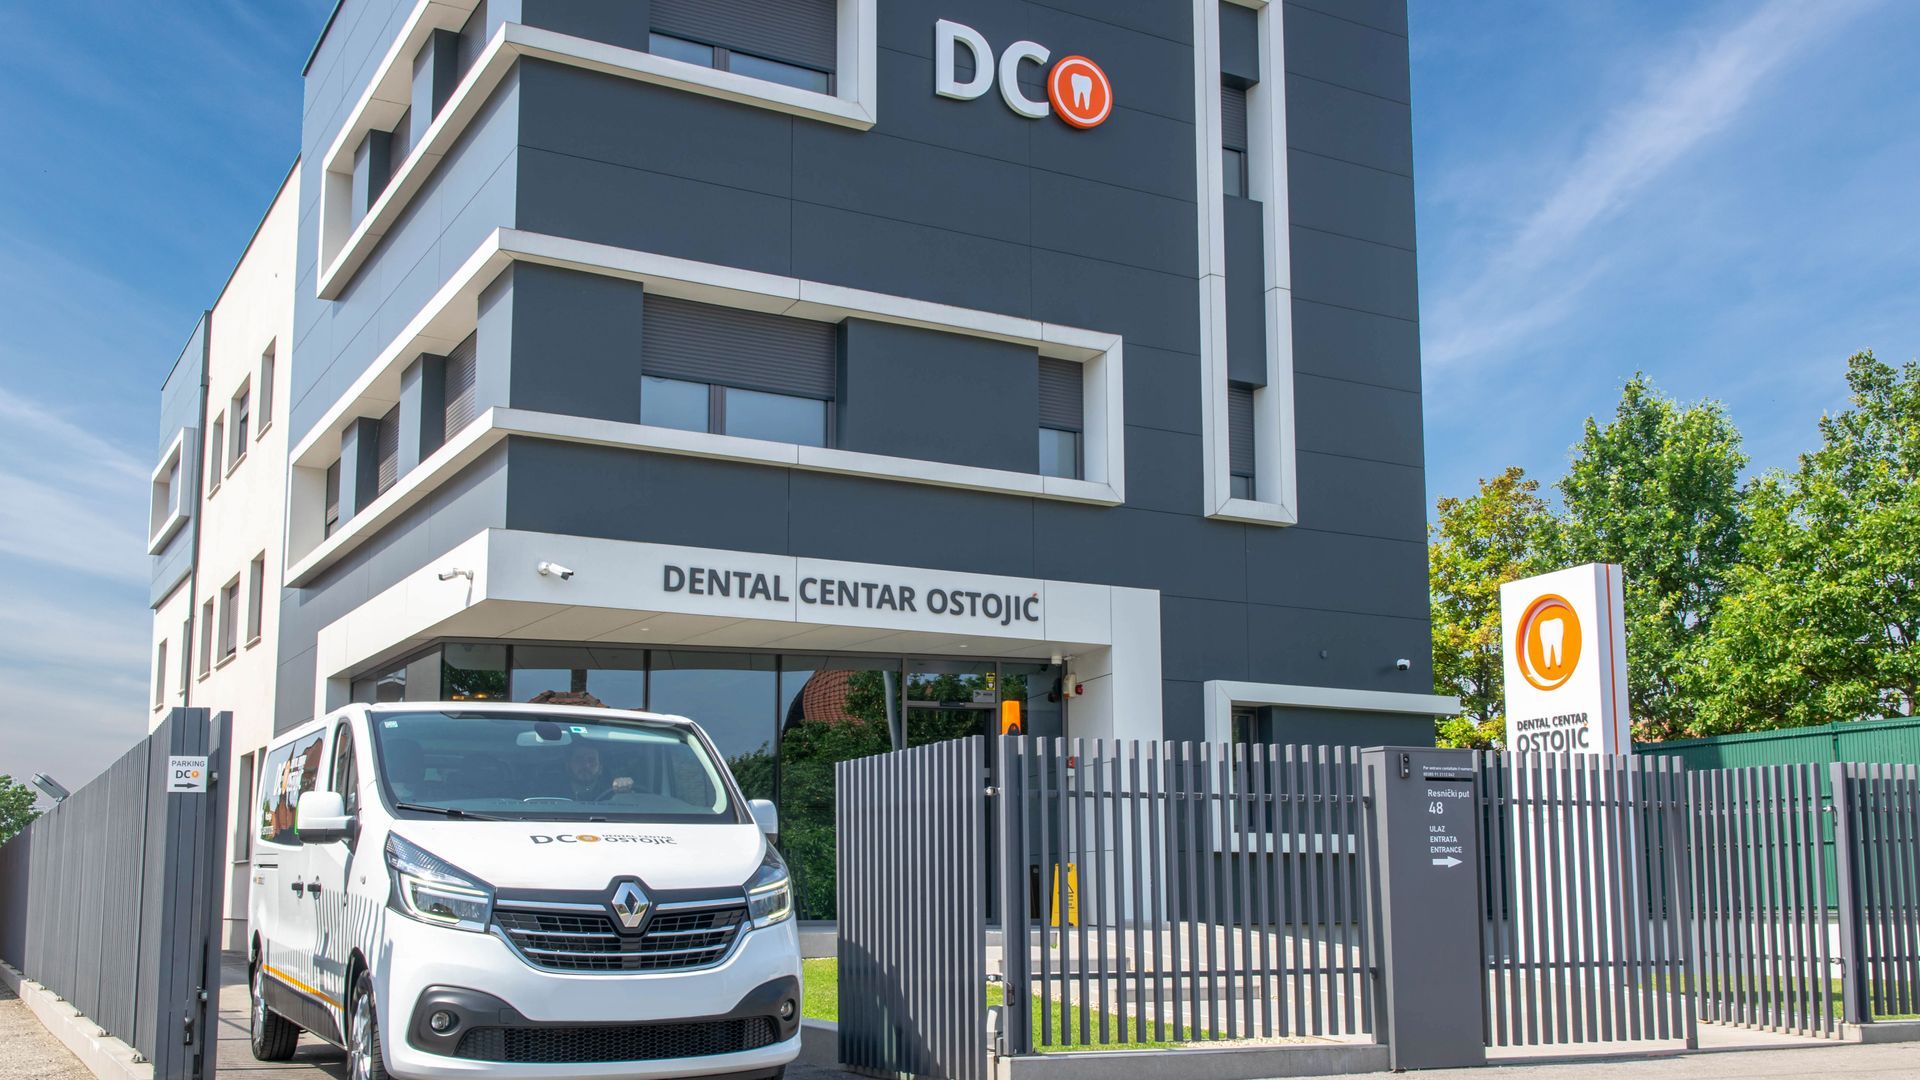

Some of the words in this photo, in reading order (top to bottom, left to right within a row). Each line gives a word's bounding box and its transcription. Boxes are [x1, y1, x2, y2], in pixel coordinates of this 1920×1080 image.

[663, 564, 790, 602] DENTAL
[799, 576, 918, 613] CENTAR
[925, 588, 1041, 627] OSTOJIĆ
[1517, 717, 1550, 732] DENTAL
[1552, 712, 1588, 727] CENTAR
[1427, 788, 1457, 798] Resnički
[1458, 790, 1470, 799] put
[1429, 801, 1444, 815] 48
[1429, 825, 1445, 833] ULAZ
[1430, 846, 1462, 854] ENTRANCE
